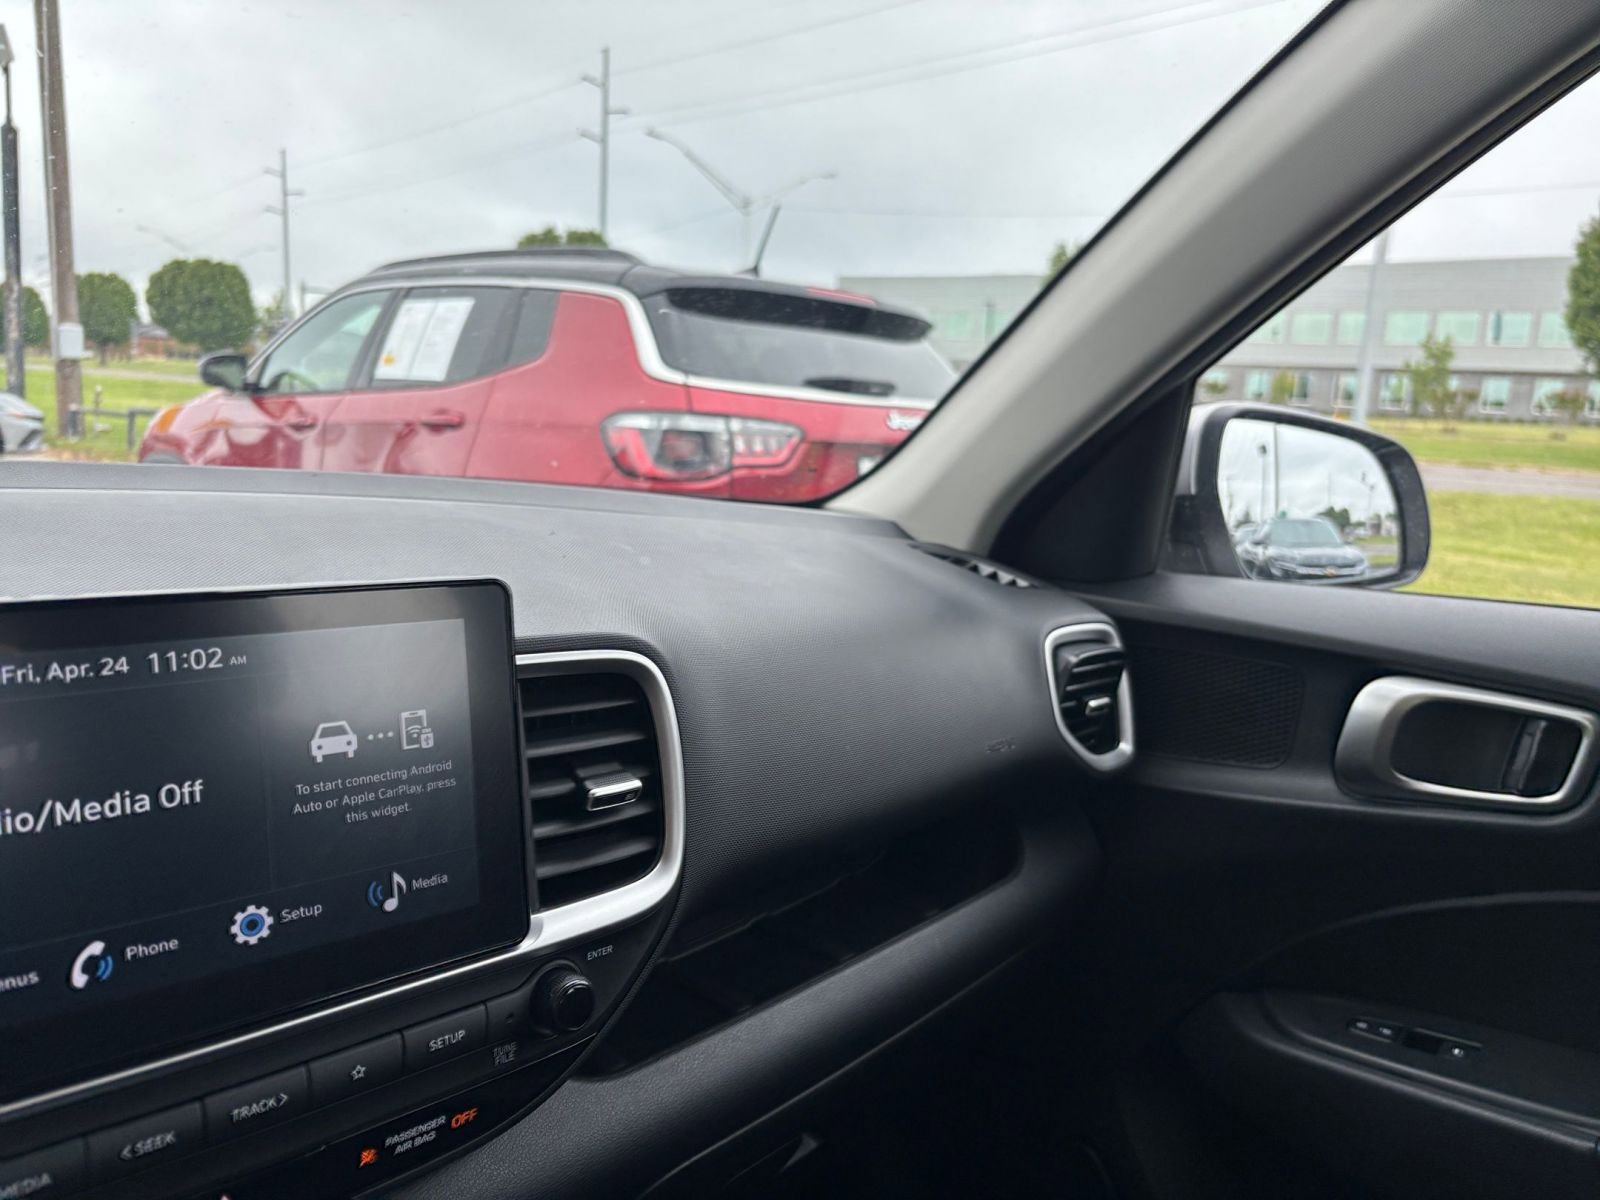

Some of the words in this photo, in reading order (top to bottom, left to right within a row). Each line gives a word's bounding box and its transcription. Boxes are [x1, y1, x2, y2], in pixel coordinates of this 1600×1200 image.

[47, 661, 94, 683] Apr.
[99, 655, 130, 677] 24
[148, 647, 224, 674] 11:02
[229, 655, 248, 667] AM
[296, 783, 311, 796] To
[313, 777, 343, 793] start
[345, 768, 408, 788] connecting
[410, 760, 452, 777] Android
[0, 790, 151, 836] io/Media
[158, 779, 204, 809] Off
[292, 801, 323, 816] Auto
[325, 799, 340, 809] or
[342, 790, 376, 807] Apple
[427, 776, 457, 792] press
[346, 810, 369, 824] this
[412, 872, 449, 891] Media
[280, 902, 323, 923] Setup
[124, 938, 179, 961] Phone
[587, 945, 613, 960] ENTER
[428, 1030, 466, 1051] SETUP
[494, 1052, 515, 1066] FILE
[230, 1098, 278, 1123] TRACK
[450, 1108, 479, 1130] OFF
[133, 1130, 176, 1157] SEEK
[384, 1115, 446, 1148] PASSENGER
[394, 1140, 413, 1157] AIR
[413, 1130, 437, 1148] BAG
